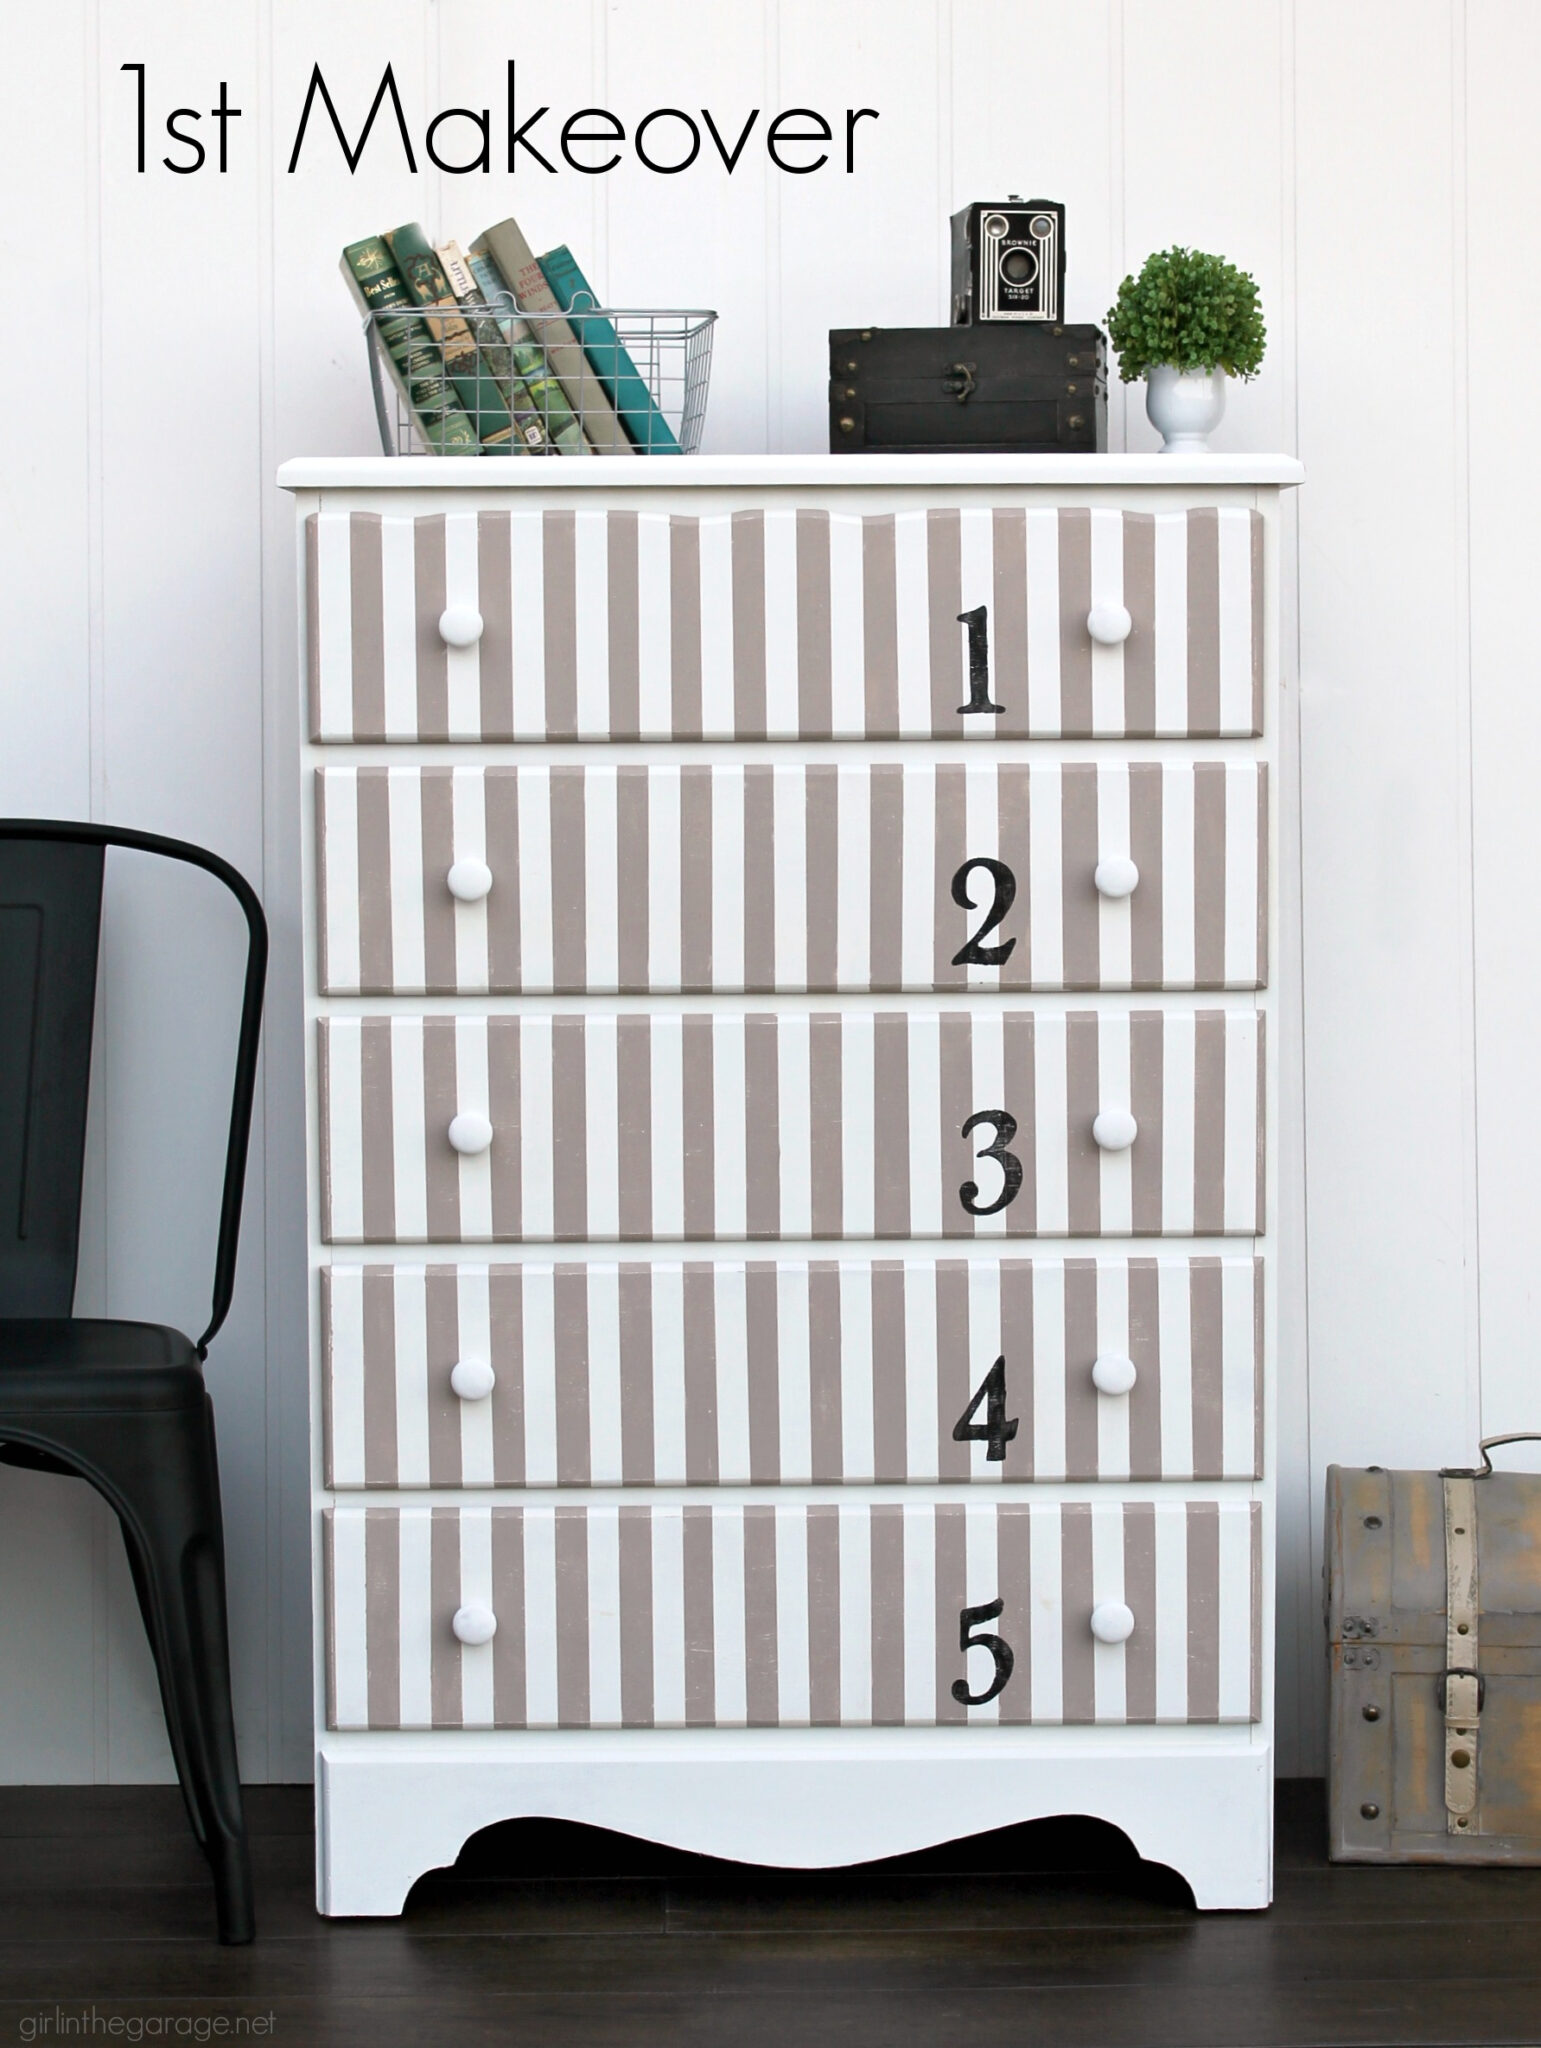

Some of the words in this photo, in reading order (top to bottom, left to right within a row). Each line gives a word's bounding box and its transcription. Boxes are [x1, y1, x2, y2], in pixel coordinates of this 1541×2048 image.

[1001, 239, 1037, 247] BROWNIE
[518, 262, 538, 276] THE
[518, 271, 545, 289] FOUR
[363, 283, 382, 298] Best
[518, 281, 549, 299] WINDS
[1004, 287, 1034, 295] TARGET
[956, 606, 1006, 714] 1
[951, 857, 1017, 967] 2
[959, 1109, 1023, 1216] 3
[952, 1356, 1019, 1462] 4
[952, 1598, 1015, 1706] 5
